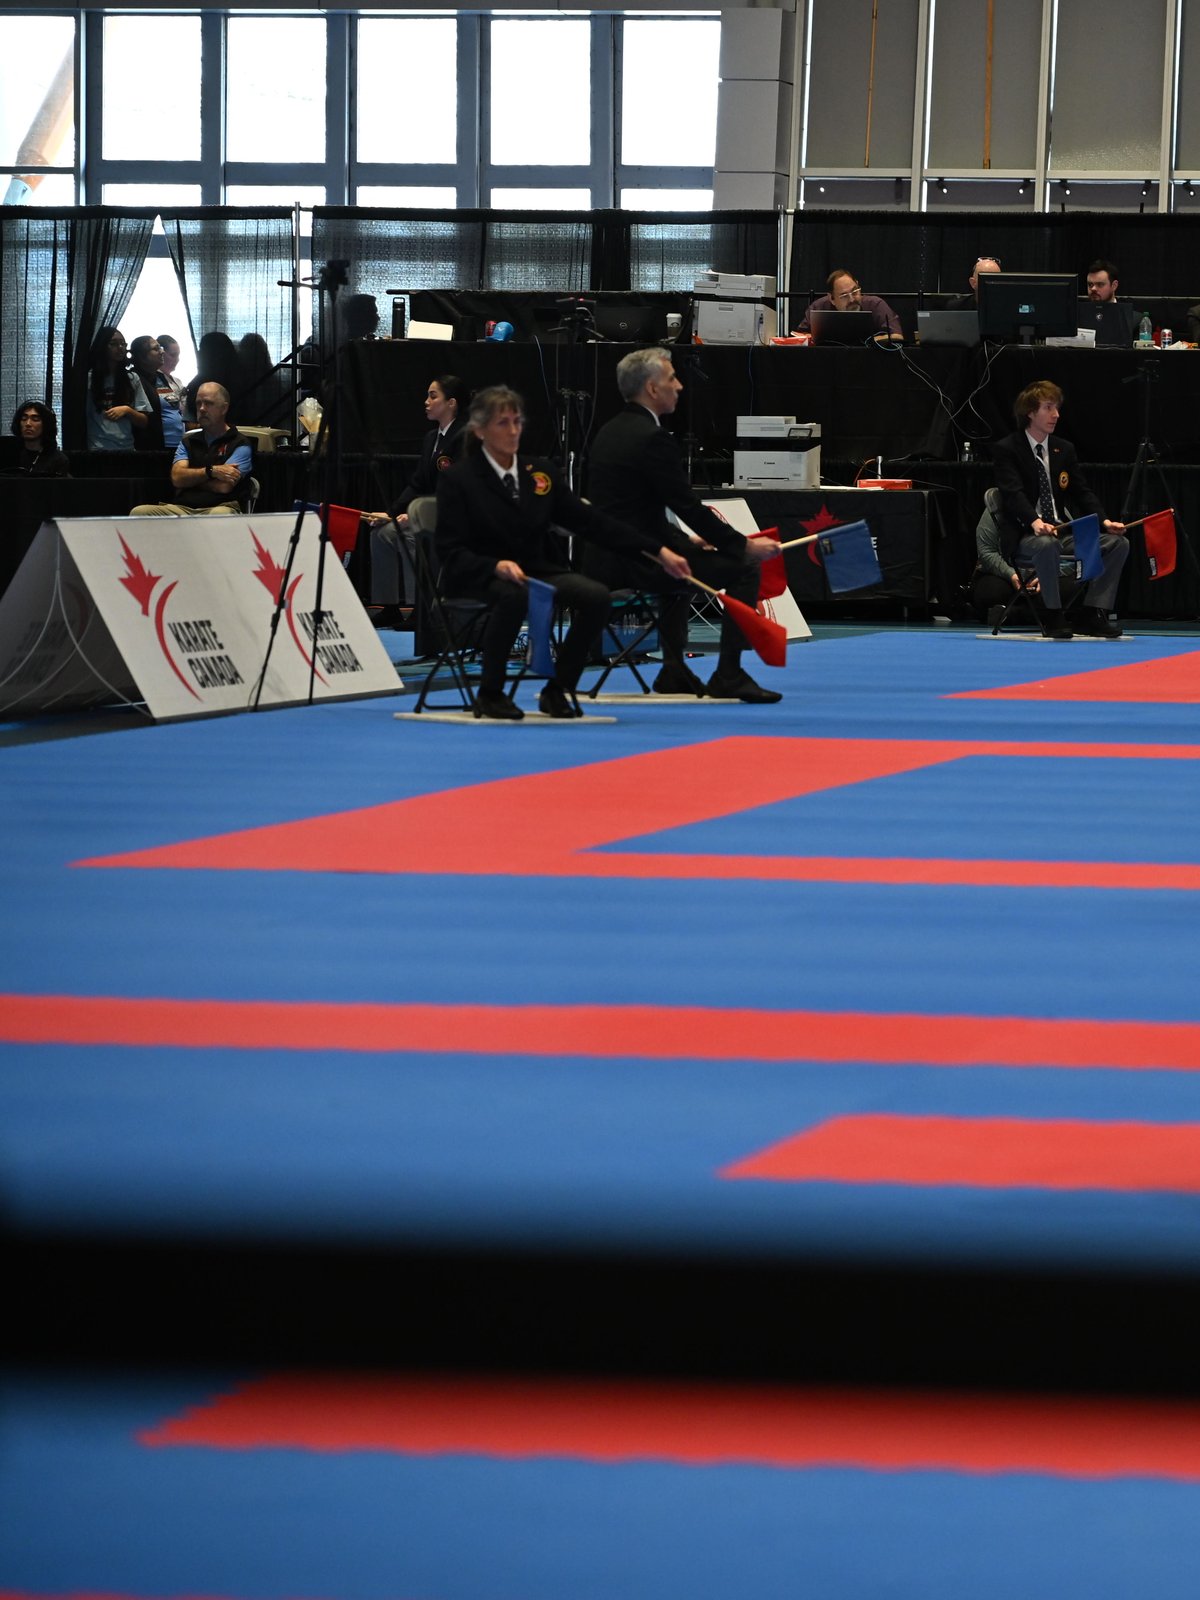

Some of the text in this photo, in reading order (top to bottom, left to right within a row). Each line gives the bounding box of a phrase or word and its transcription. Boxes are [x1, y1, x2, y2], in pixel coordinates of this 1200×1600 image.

[168, 620, 224, 653] KARATE
[187, 655, 244, 688] CANADA
[315, 643, 363, 674] CANADA
